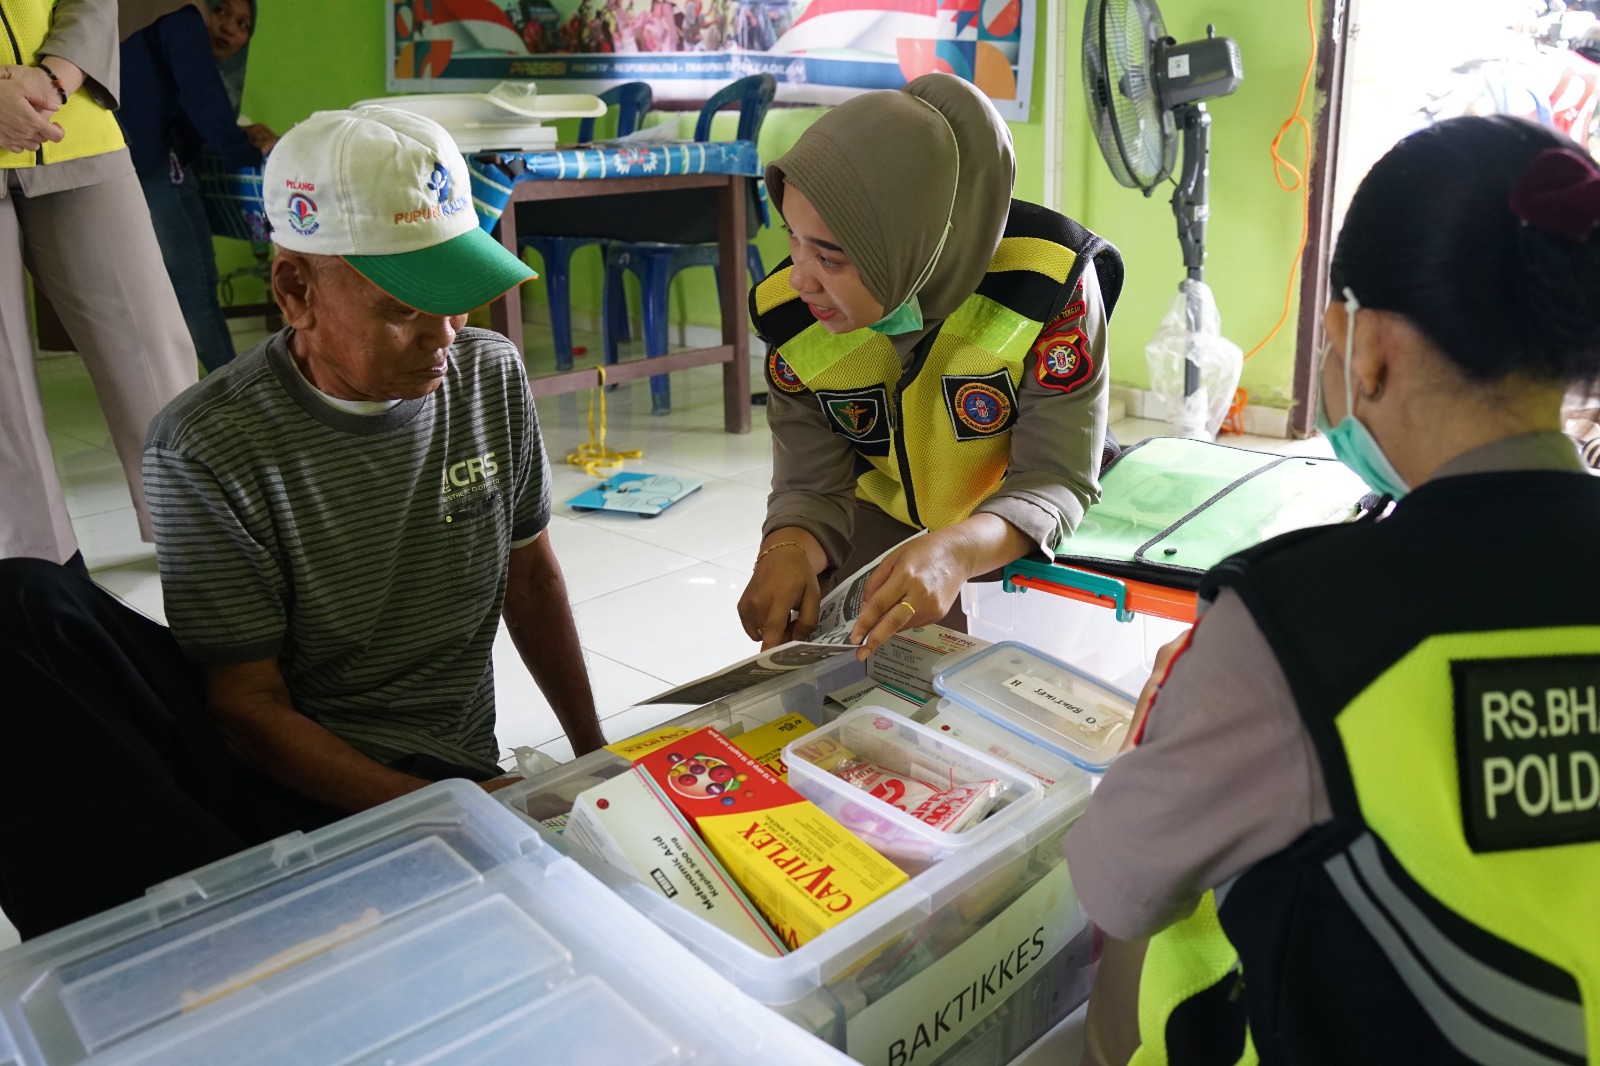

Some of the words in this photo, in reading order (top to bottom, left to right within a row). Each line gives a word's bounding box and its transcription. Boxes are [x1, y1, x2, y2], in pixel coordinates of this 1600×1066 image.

[285, 179, 315, 192] PELANGI
[394, 204, 441, 225] PUPUK
[1034, 688, 1084, 714] BAKTIKES
[1481, 685, 1600, 742] RS.BH
[1482, 751, 1600, 820] POLD
[652, 835, 674, 856] Acid
[671, 837, 683, 851] mg
[681, 852, 697, 868] 500
[737, 820, 853, 913] CAVIPLEX
[672, 857, 715, 911] Mefenamic
[695, 869, 719, 898] Kaplet
[887, 926, 1045, 1066] BAKTIKKES
